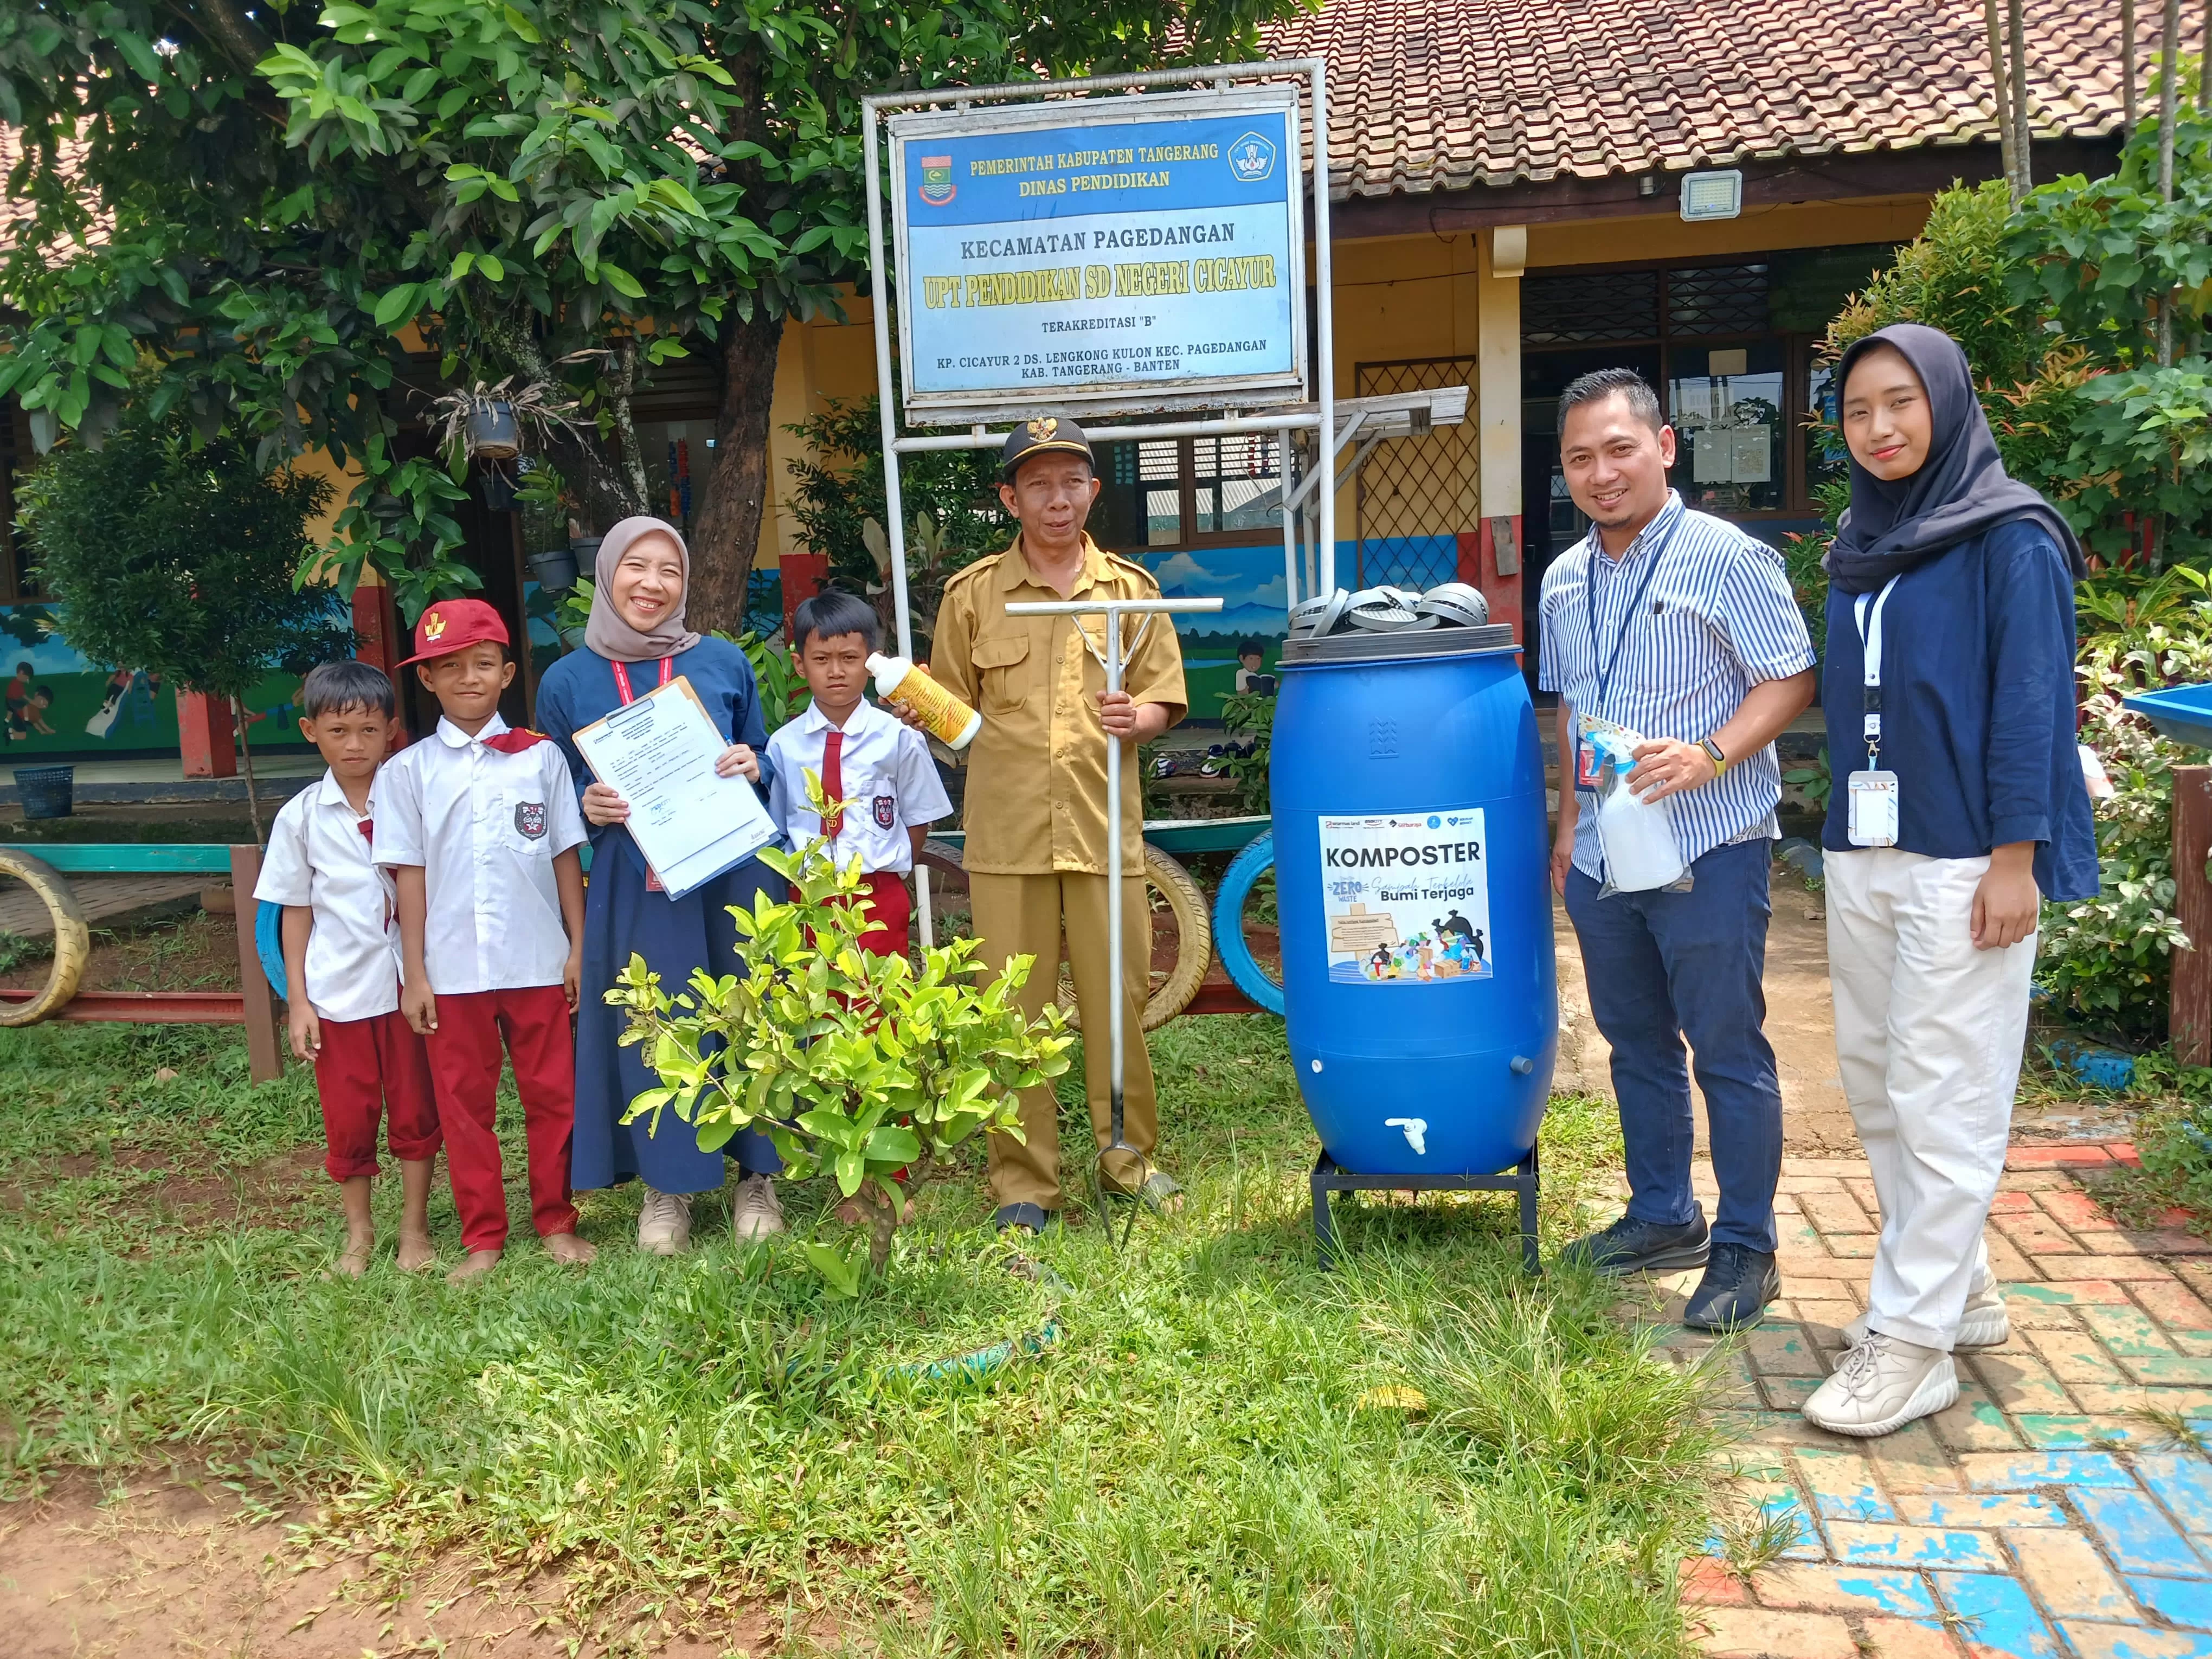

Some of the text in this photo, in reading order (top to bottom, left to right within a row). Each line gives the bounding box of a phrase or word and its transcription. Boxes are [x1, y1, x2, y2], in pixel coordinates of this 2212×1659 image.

[970, 155, 1054, 176] PEMERINTAH
[1057, 148, 1133, 169] KABUPATEN
[1138, 143, 1219, 162] TANGERANG
[1019, 171, 1170, 197] DINAS PENDIDIKAN
[961, 223, 1234, 259] KECAMATAN PAGEDANGAN
[923, 254, 1276, 309] UPT PENDIDIKAN SD NEGERI CICAYUR
[1041, 316, 1156, 332] TERAKREDITASI "B"
[937, 339, 1266, 369] KP. CICAYUR 2 DS. LENGKONG KULON KEC. PAGEDANGAN
[1021, 368, 1047, 378] KAB.
[1052, 363, 1122, 377] TANGERANG
[1134, 359, 1180, 372] BANTEN
[1326, 841, 1480, 867] KOMPOSTER
[1333, 881, 1362, 895] ZERO
[1381, 886, 1474, 902] Bumi Terjaga
